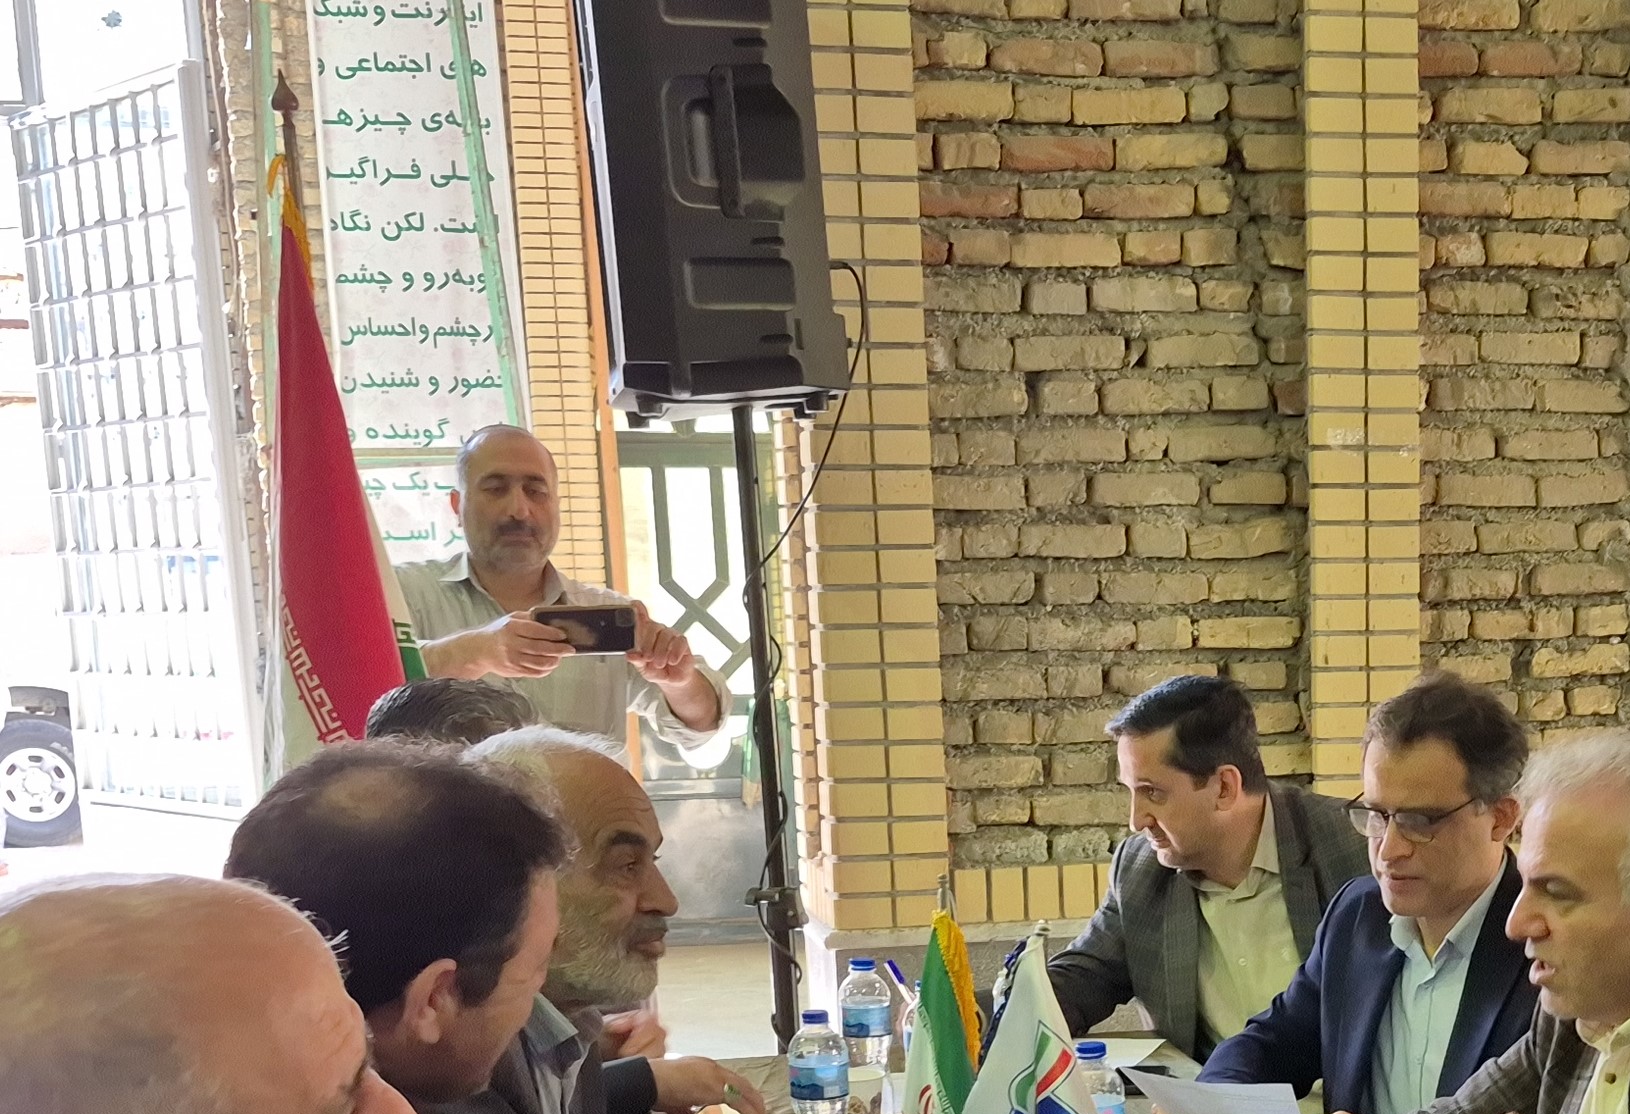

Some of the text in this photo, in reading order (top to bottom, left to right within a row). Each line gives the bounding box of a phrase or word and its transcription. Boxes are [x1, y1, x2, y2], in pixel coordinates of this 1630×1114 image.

[373, 4, 386, 27] و
[335, 52, 431, 80] اجتماعی
[326, 156, 421, 187] فراگی
[381, 211, 424, 242] لکن
[401, 271, 415, 293] و
[433, 317, 482, 348] چشم
[341, 368, 420, 394] شنیدن
[428, 375, 440, 396] و
[366, 418, 450, 447] گوینده
[393, 472, 429, 496] یک
